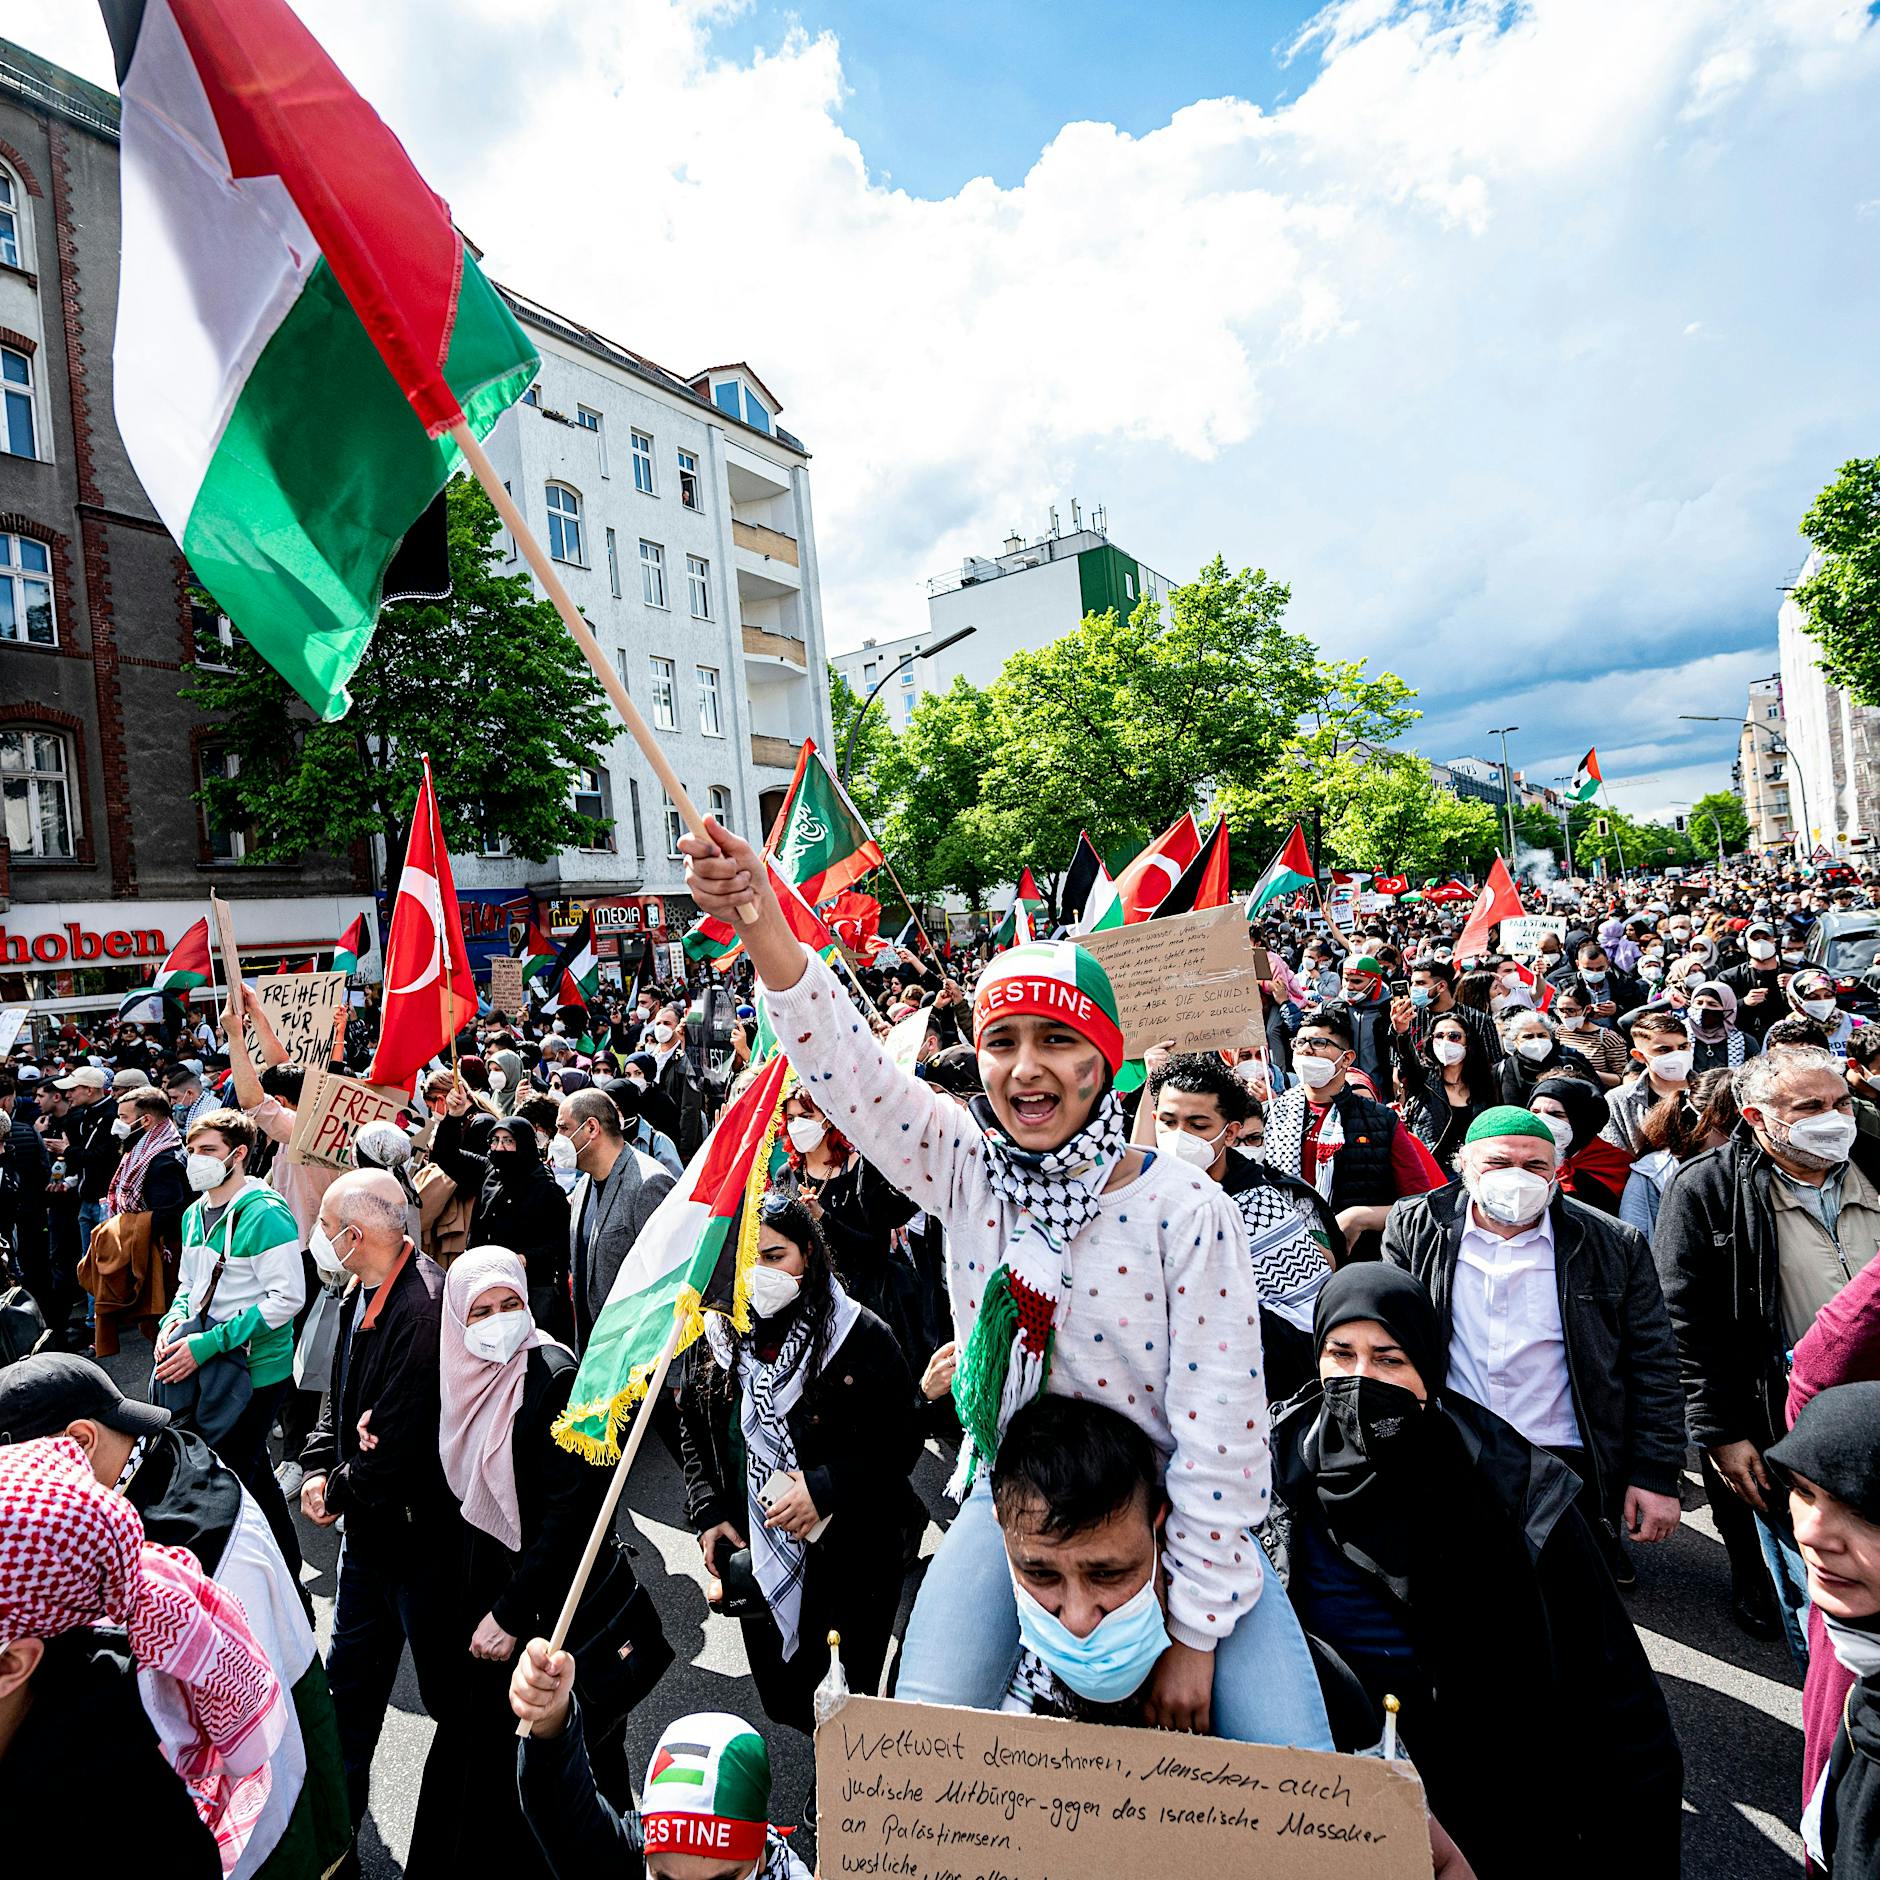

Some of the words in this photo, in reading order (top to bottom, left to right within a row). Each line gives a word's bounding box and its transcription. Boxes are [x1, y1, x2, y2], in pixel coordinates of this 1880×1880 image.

[0, 923, 170, 964] hoben
[1522, 930, 1545, 939] LIVE
[1174, 993, 1197, 1007] DIE
[281, 1004, 312, 1034] FÜR
[1175, 1010, 1205, 1022] STEIN
[329, 1084, 394, 1125] FREE
[842, 1723, 966, 1761] Weltweit
[1278, 1775, 1350, 1808] auch
[1112, 1797, 1147, 1821] das
[841, 1817, 867, 1834] an
